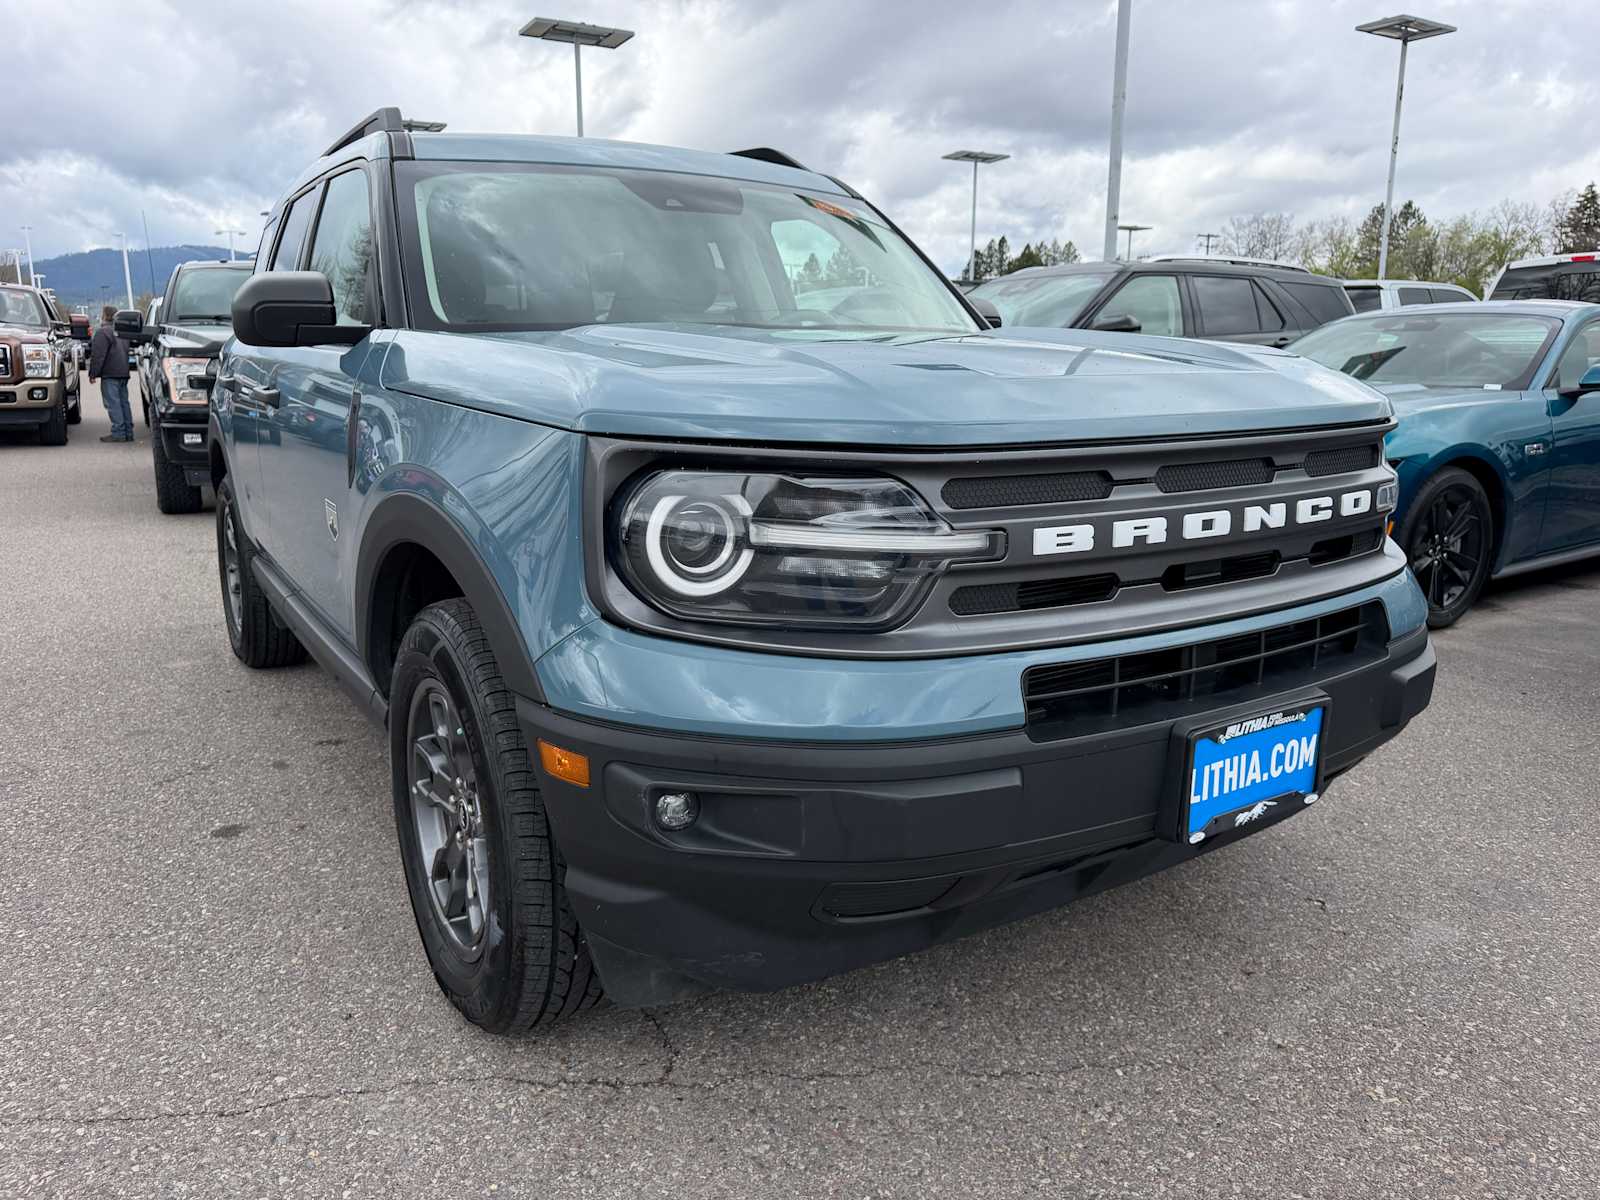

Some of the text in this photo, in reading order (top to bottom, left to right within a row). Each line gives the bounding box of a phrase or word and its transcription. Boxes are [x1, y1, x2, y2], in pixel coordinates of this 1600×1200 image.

[1033, 489, 1372, 556] BRONCO
[1234, 716, 1268, 738] LITHIA
[1190, 733, 1318, 805] LITHIA.COM
